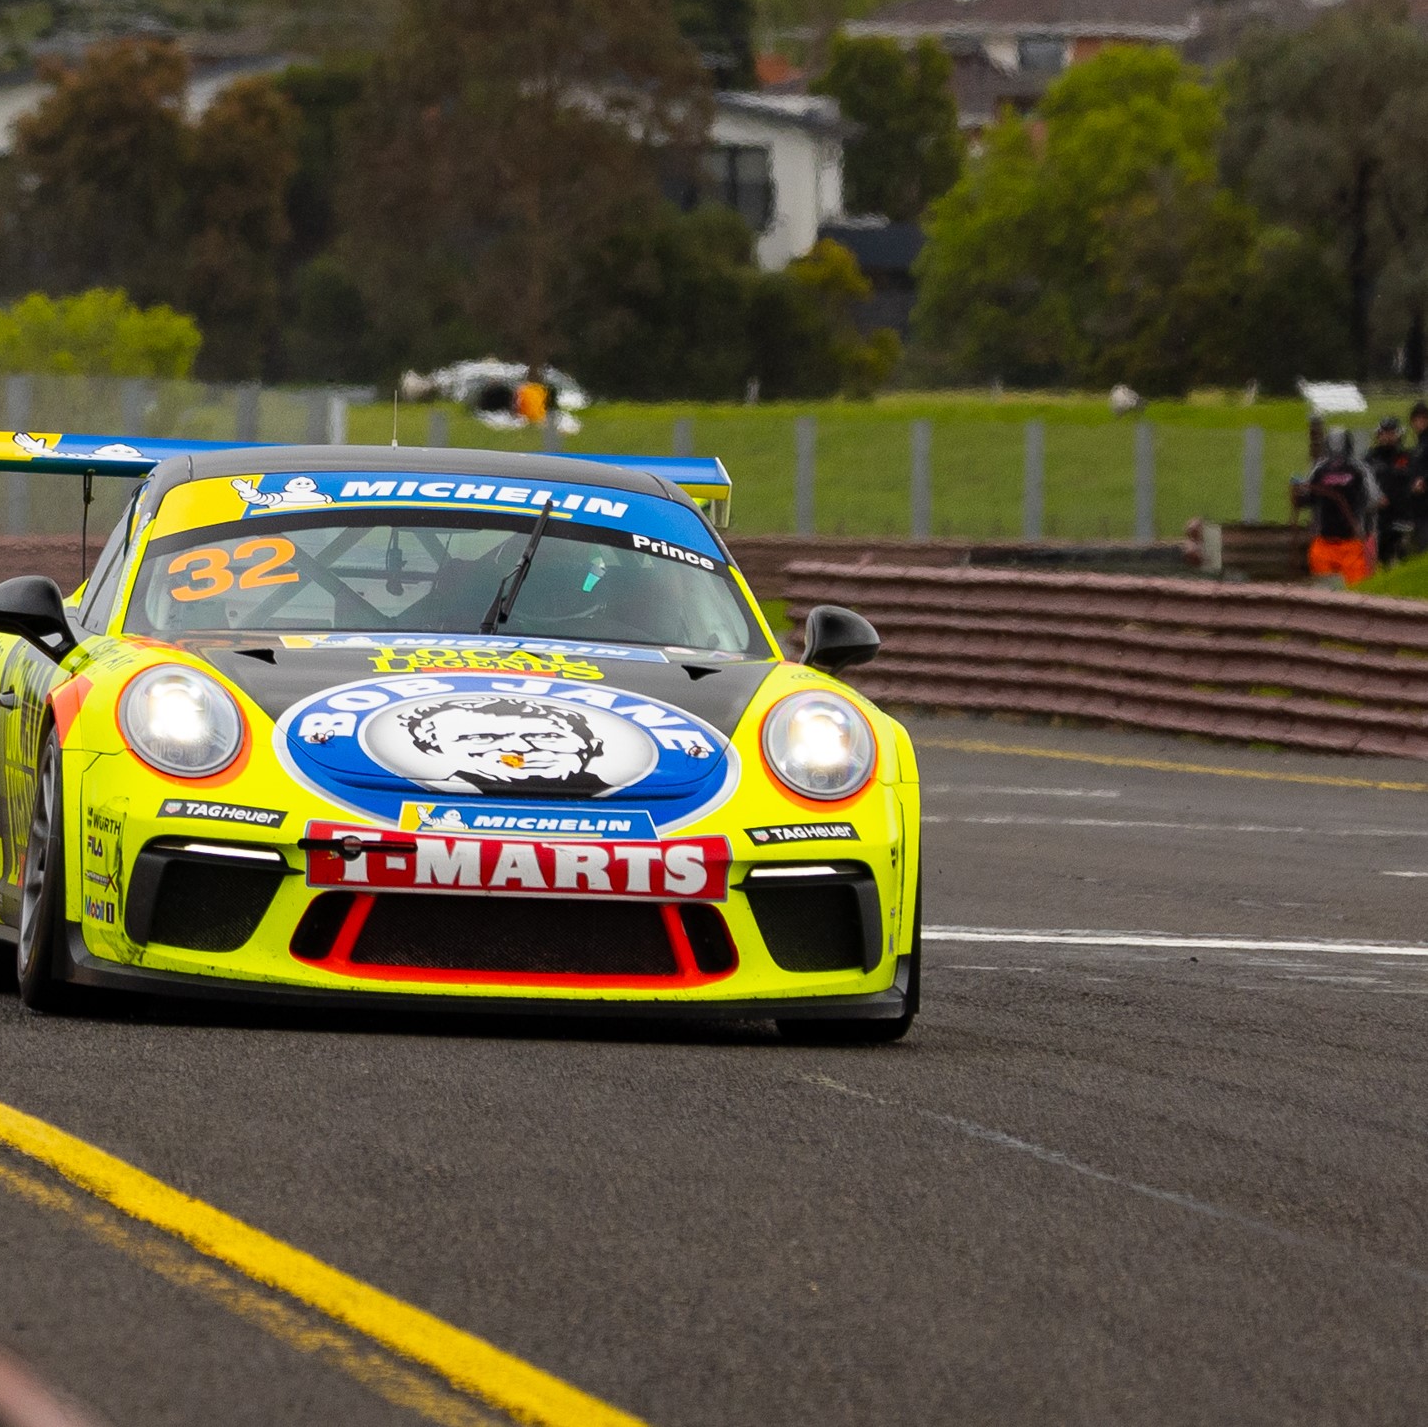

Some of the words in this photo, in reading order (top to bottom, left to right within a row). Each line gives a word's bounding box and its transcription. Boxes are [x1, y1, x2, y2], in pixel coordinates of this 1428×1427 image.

[340, 480, 629, 519] MICHELIN
[632, 533, 716, 572] Prince
[168, 538, 299, 603] 32
[373, 647, 589, 666] LOCAL
[384, 638, 633, 658] MICHELIN
[368, 657, 605, 681] LEGENDS
[299, 677, 456, 739] BOB
[491, 678, 715, 753] JANE
[473, 815, 632, 832] MICHELIN
[87, 835, 104, 858] FILA
[330, 829, 708, 895] T-MARTS
[85, 897, 105, 922] Mobil
